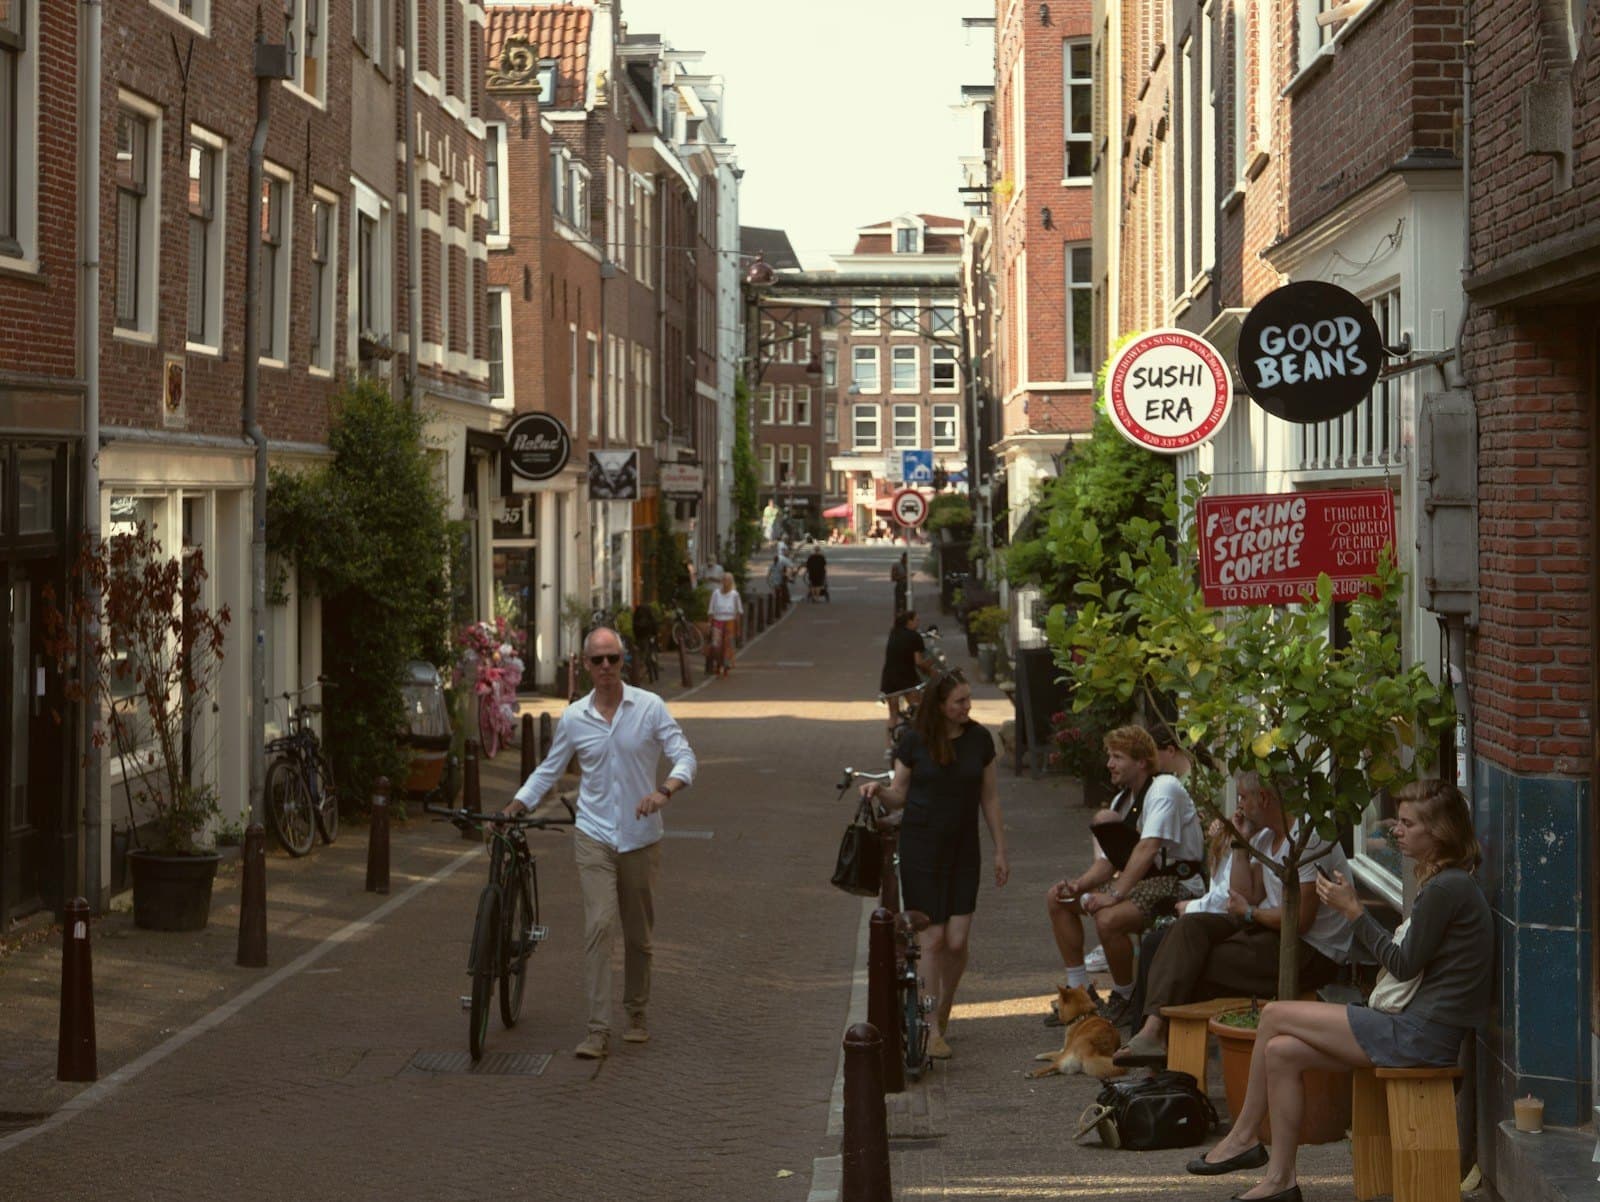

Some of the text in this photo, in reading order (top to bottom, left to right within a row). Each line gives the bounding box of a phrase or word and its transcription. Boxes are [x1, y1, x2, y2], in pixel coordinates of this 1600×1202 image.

[1153, 335, 1183, 345] SUSHI
[1259, 316, 1361, 355] GOOD
[1133, 364, 1202, 389] SUSHI
[1254, 345, 1367, 389] BEANS
[1115, 400, 1134, 427] SUSHI
[1145, 397, 1192, 423] ERA
[1209, 395, 1225, 424] SUSHI
[1144, 432, 1159, 444] 020
[1160, 437, 1176, 447] 337
[1206, 498, 1306, 537] FCKING
[1324, 505, 1387, 522] ETHICALLY
[1329, 520, 1388, 536] SOURCED
[1214, 522, 1305, 561] STRONG
[1329, 535, 1388, 551] SPECIALTY
[1219, 544, 1300, 585] COFFEE
[1337, 549, 1383, 566] COFFE
[1221, 587, 1238, 600] TO
[1240, 584, 1270, 599] STAY
[1276, 583, 1294, 597] TO
[1297, 581, 1314, 596] GO
